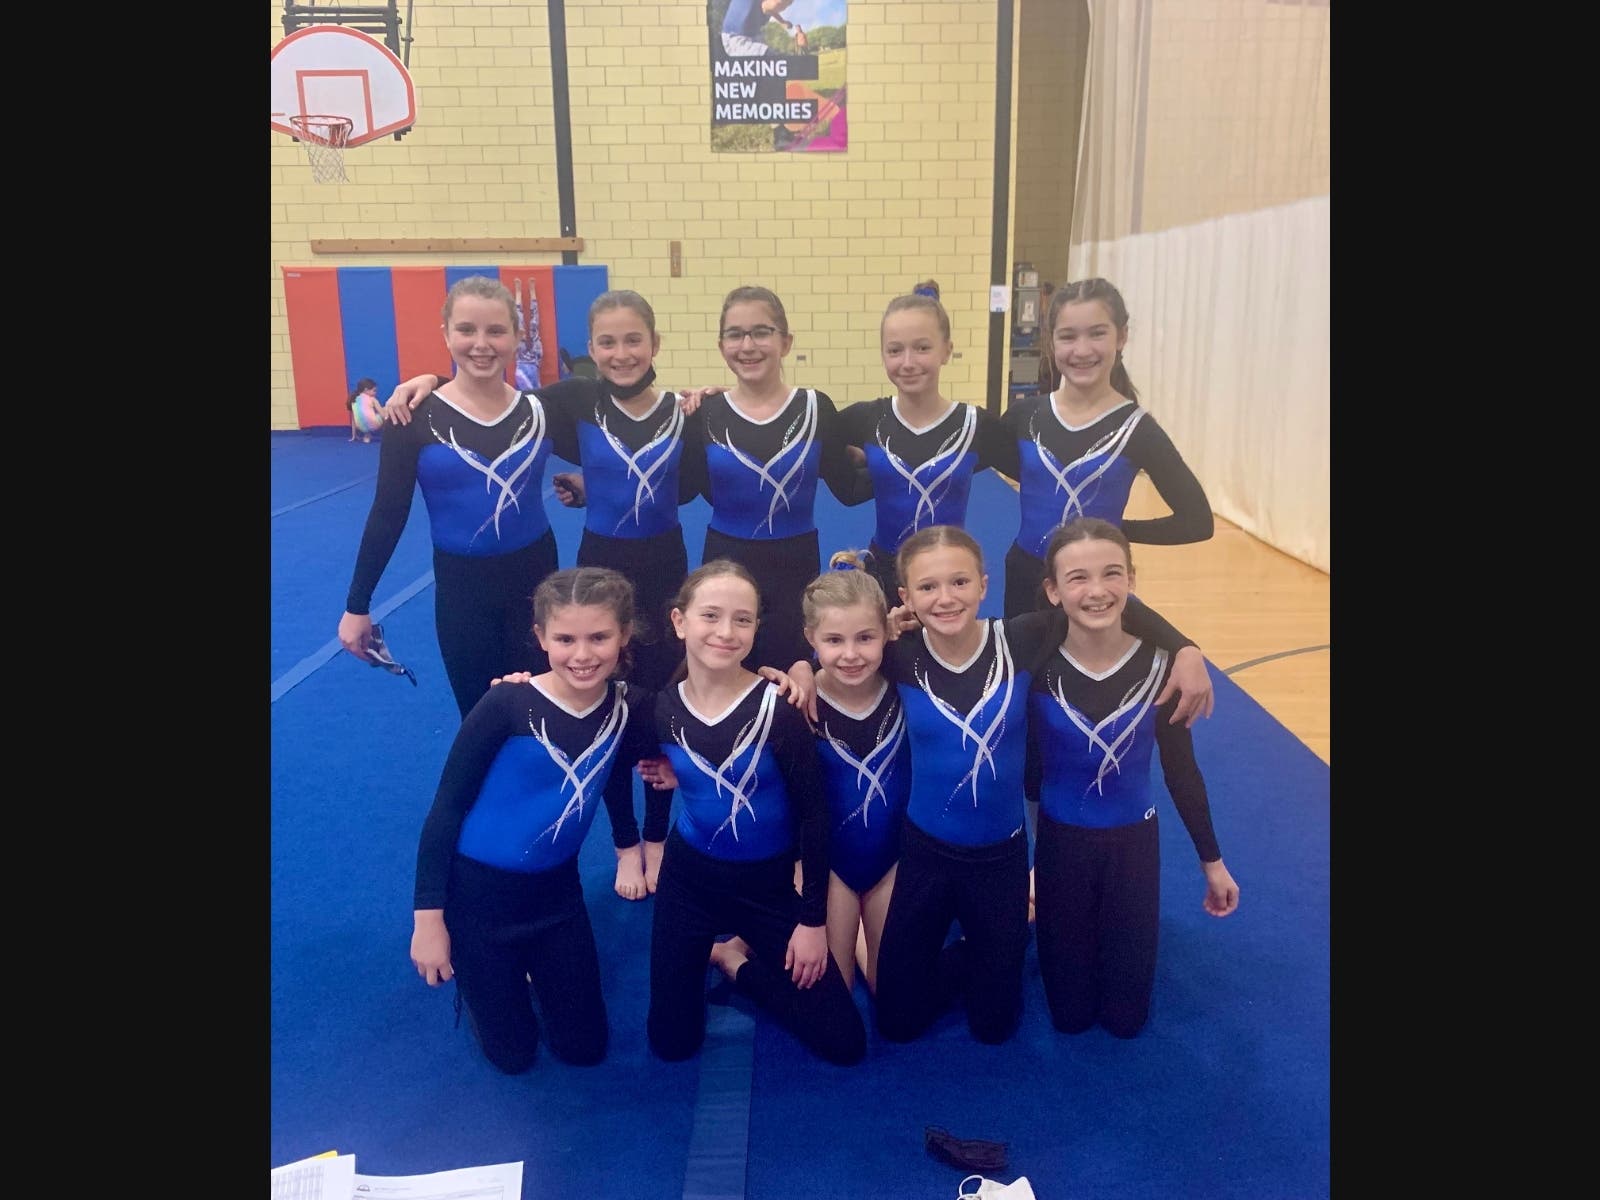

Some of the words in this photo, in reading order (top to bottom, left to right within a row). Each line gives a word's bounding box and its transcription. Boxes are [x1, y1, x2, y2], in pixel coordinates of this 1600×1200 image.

[714, 60, 787, 77] MAKING
[715, 82, 757, 98] NEW
[715, 103, 812, 120] MEMORIES
